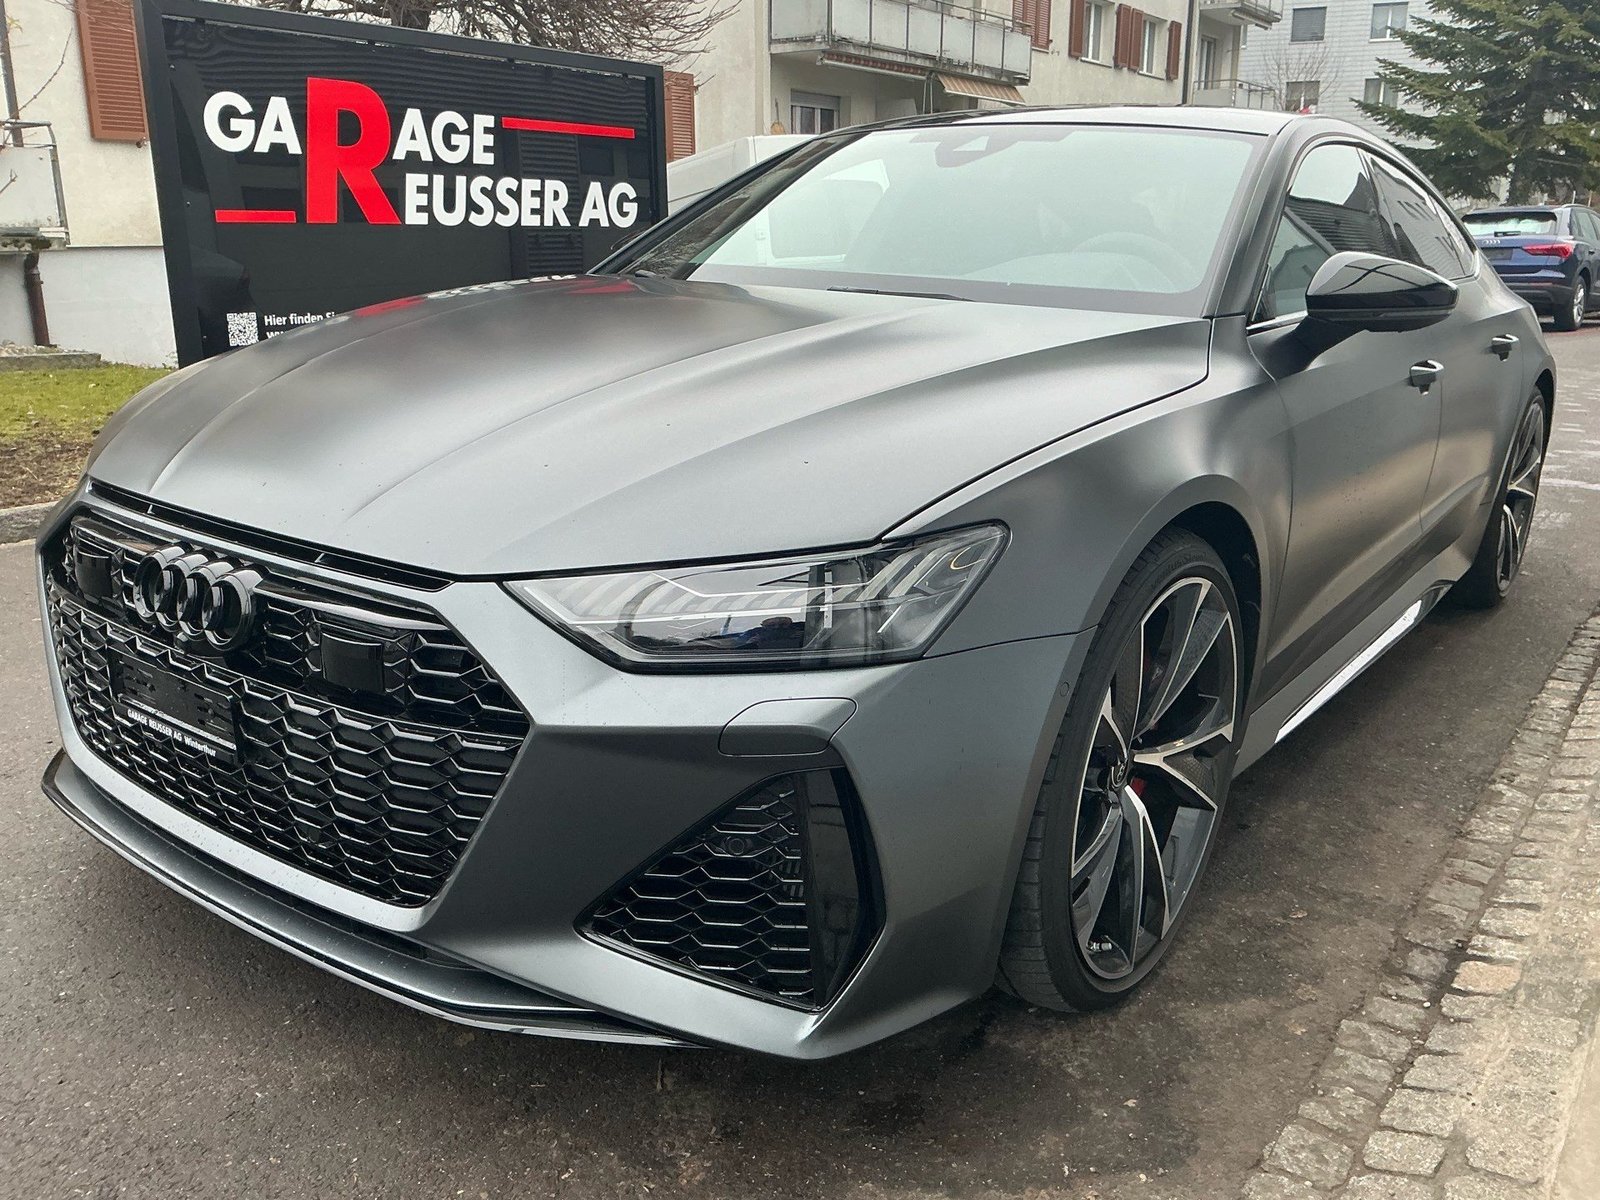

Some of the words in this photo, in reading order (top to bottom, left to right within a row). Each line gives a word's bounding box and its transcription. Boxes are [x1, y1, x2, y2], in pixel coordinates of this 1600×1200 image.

[203, 77, 495, 224] GARAGE
[579, 181, 638, 228] AG
[264, 314, 287, 326] Hier
[289, 312, 324, 325] finden
[127, 709, 149, 726] GARAGE
[149, 719, 172, 737] REUSSER
[174, 730, 183, 742] AG
[184, 735, 217, 757] Winterthur
